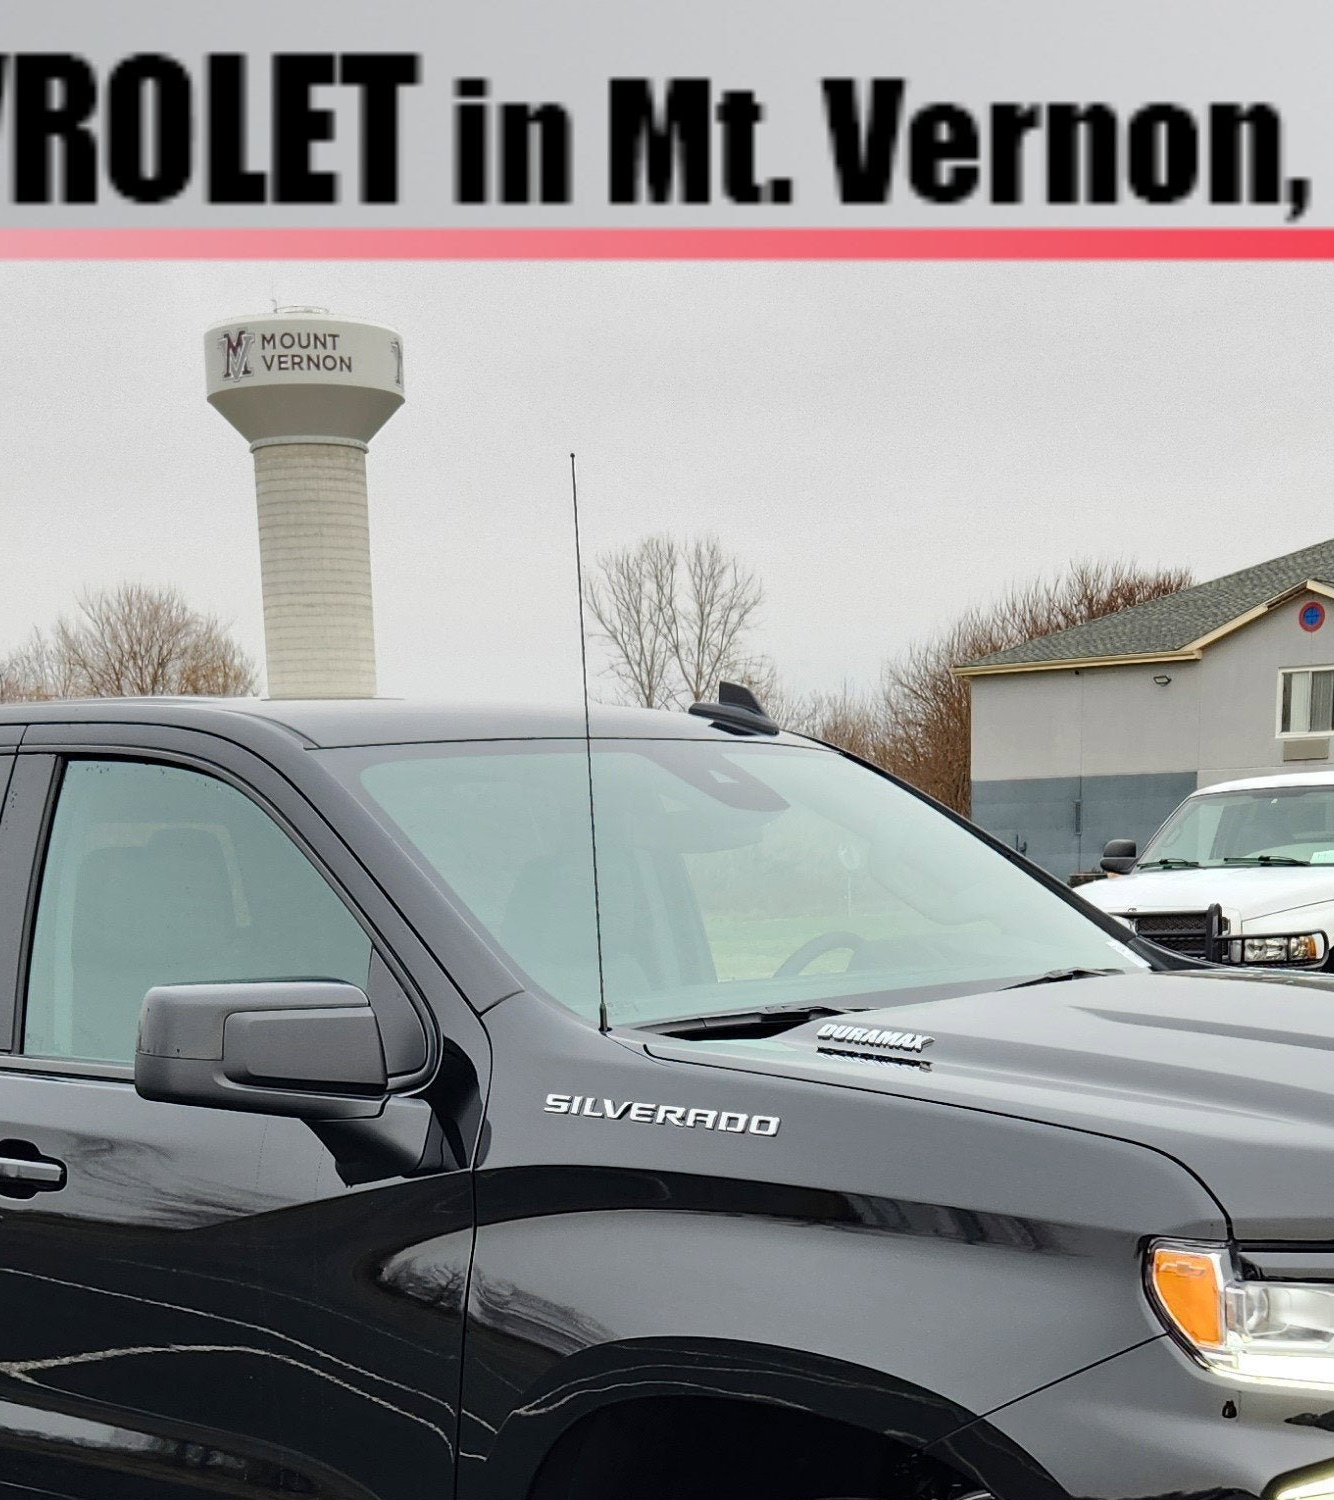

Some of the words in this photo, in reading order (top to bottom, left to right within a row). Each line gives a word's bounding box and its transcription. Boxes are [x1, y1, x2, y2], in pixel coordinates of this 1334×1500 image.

[261, 332, 340, 351] MOUNT
[261, 354, 352, 373] VERNON
[816, 1023, 936, 1053] DURAMAX
[543, 1093, 781, 1138] SILVERADO
